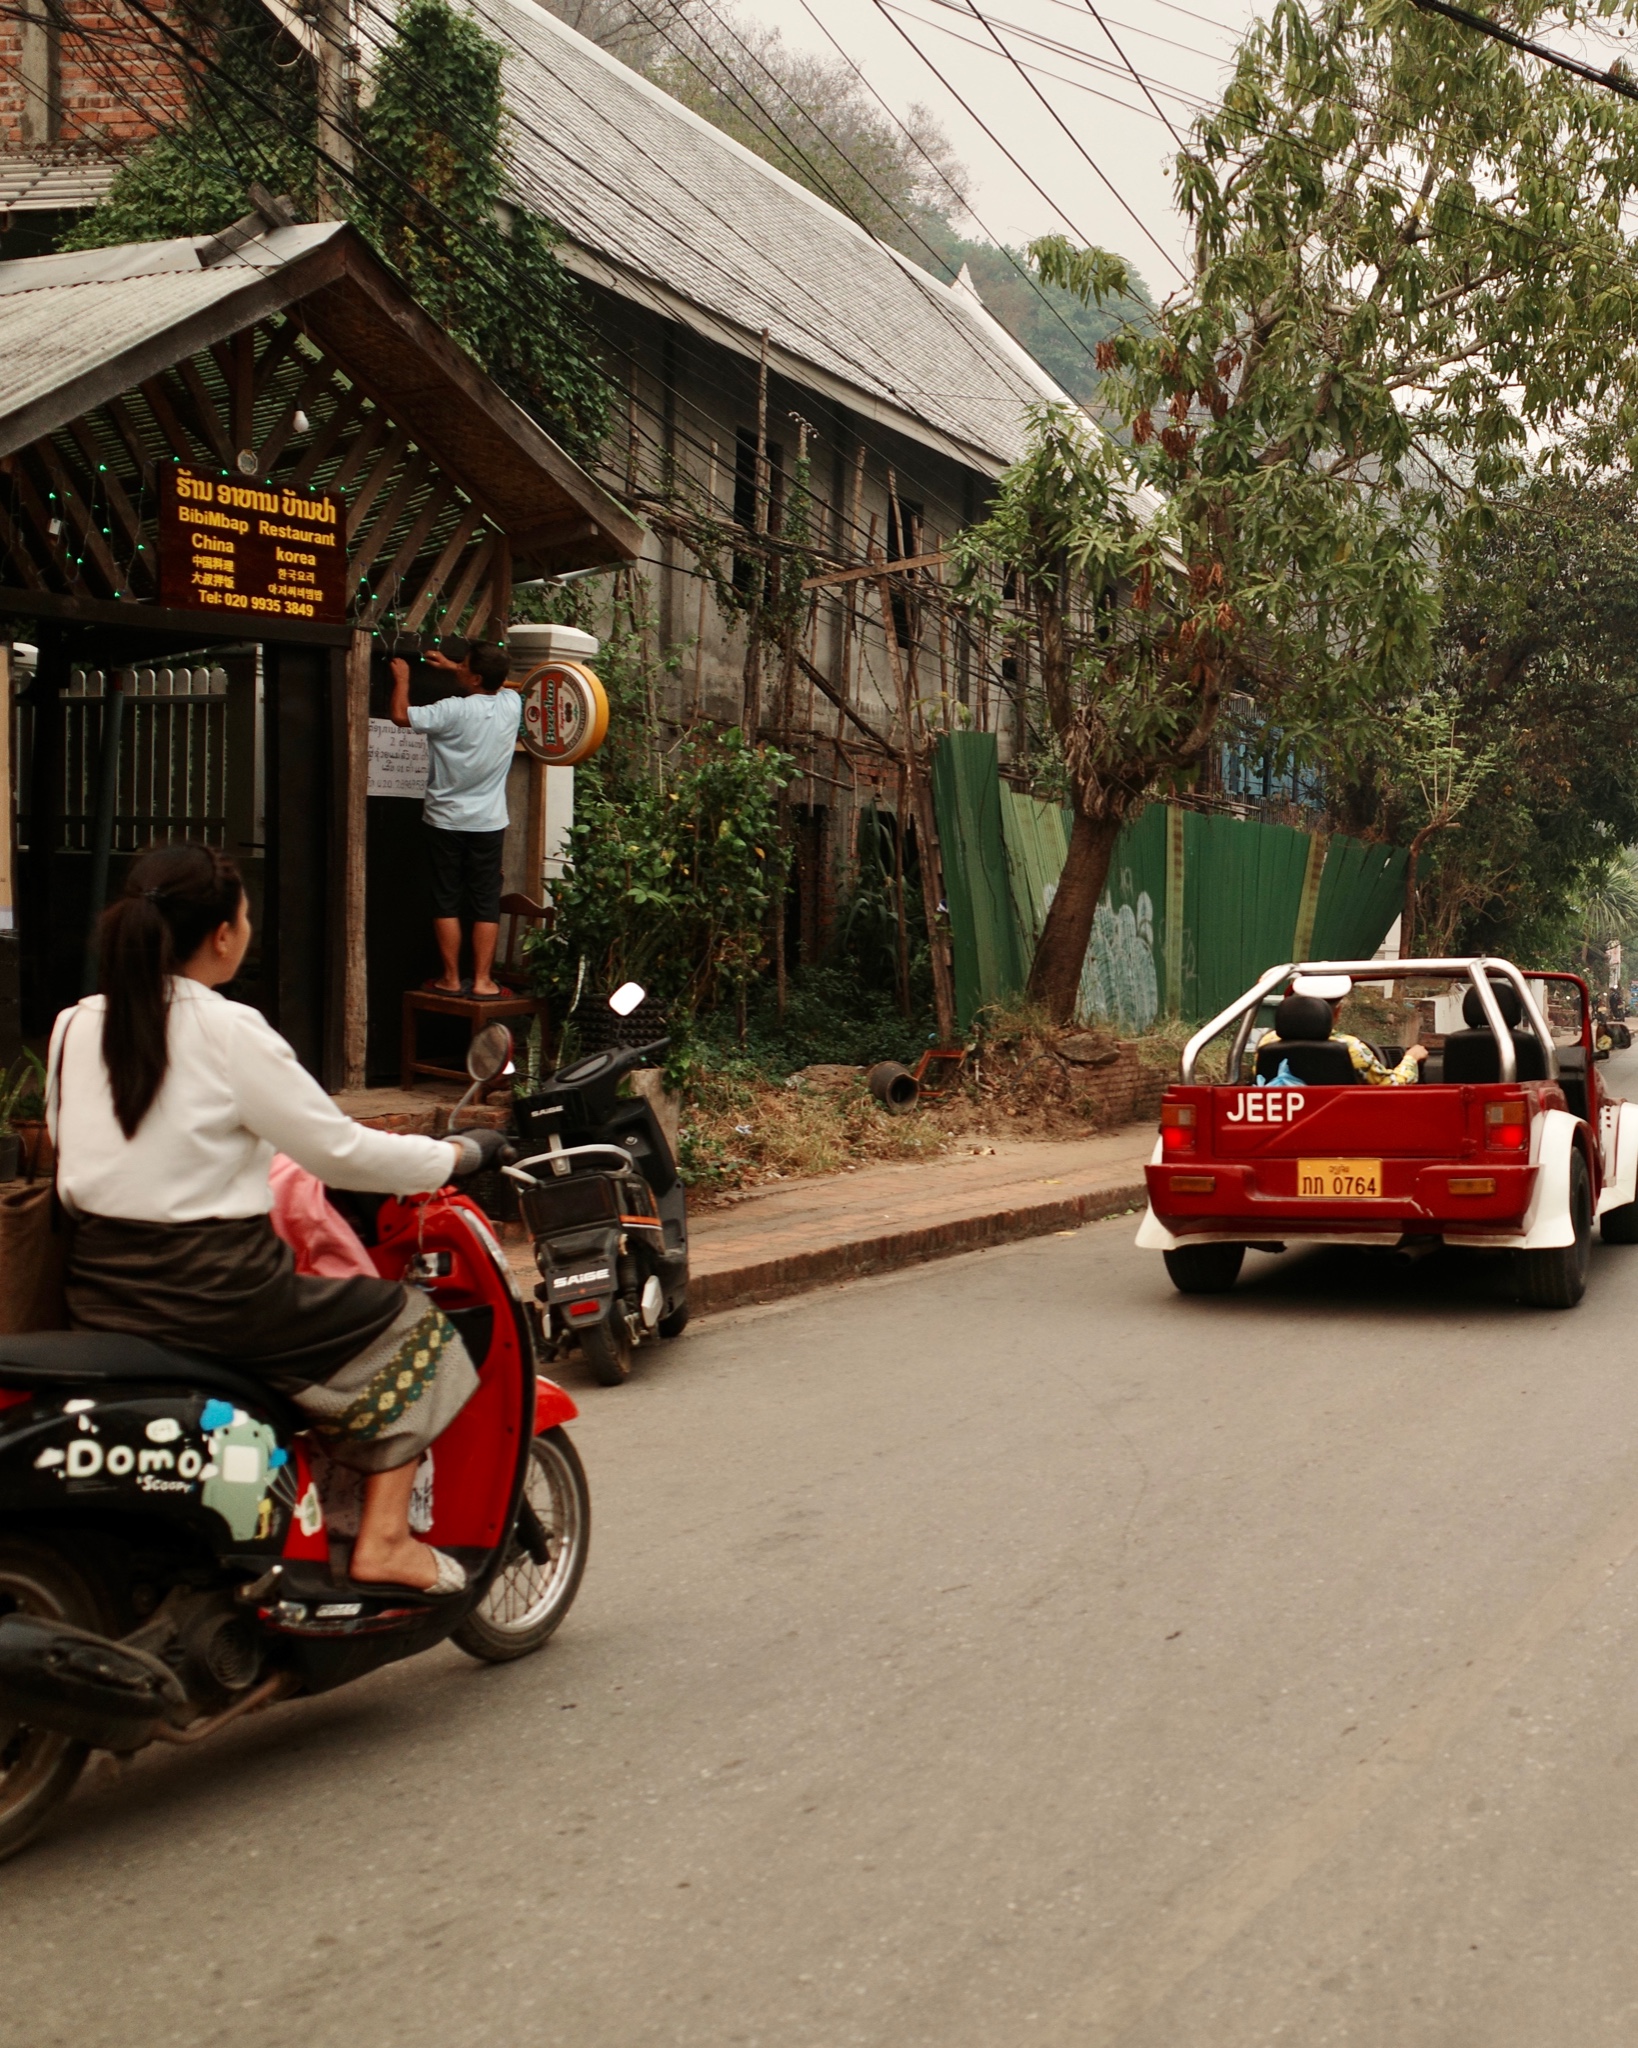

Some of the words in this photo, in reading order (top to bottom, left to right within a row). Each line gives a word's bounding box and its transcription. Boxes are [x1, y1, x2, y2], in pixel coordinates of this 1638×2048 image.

[178, 506, 249, 535] BibiMbap
[259, 520, 336, 547] Restaurant
[191, 533, 235, 553] China
[276, 546, 316, 566] korea
[277, 568, 315, 584] 한국요리
[198, 589, 222, 604] Tel:
[225, 592, 248, 608] 020
[251, 596, 281, 612] 9935
[284, 601, 314, 617] 3849
[545, 679, 556, 745] Beerlao
[1227, 1092, 1305, 1122] JEEP
[1333, 1176, 1376, 1195] 0764
[66, 1439, 202, 1478] Domo
